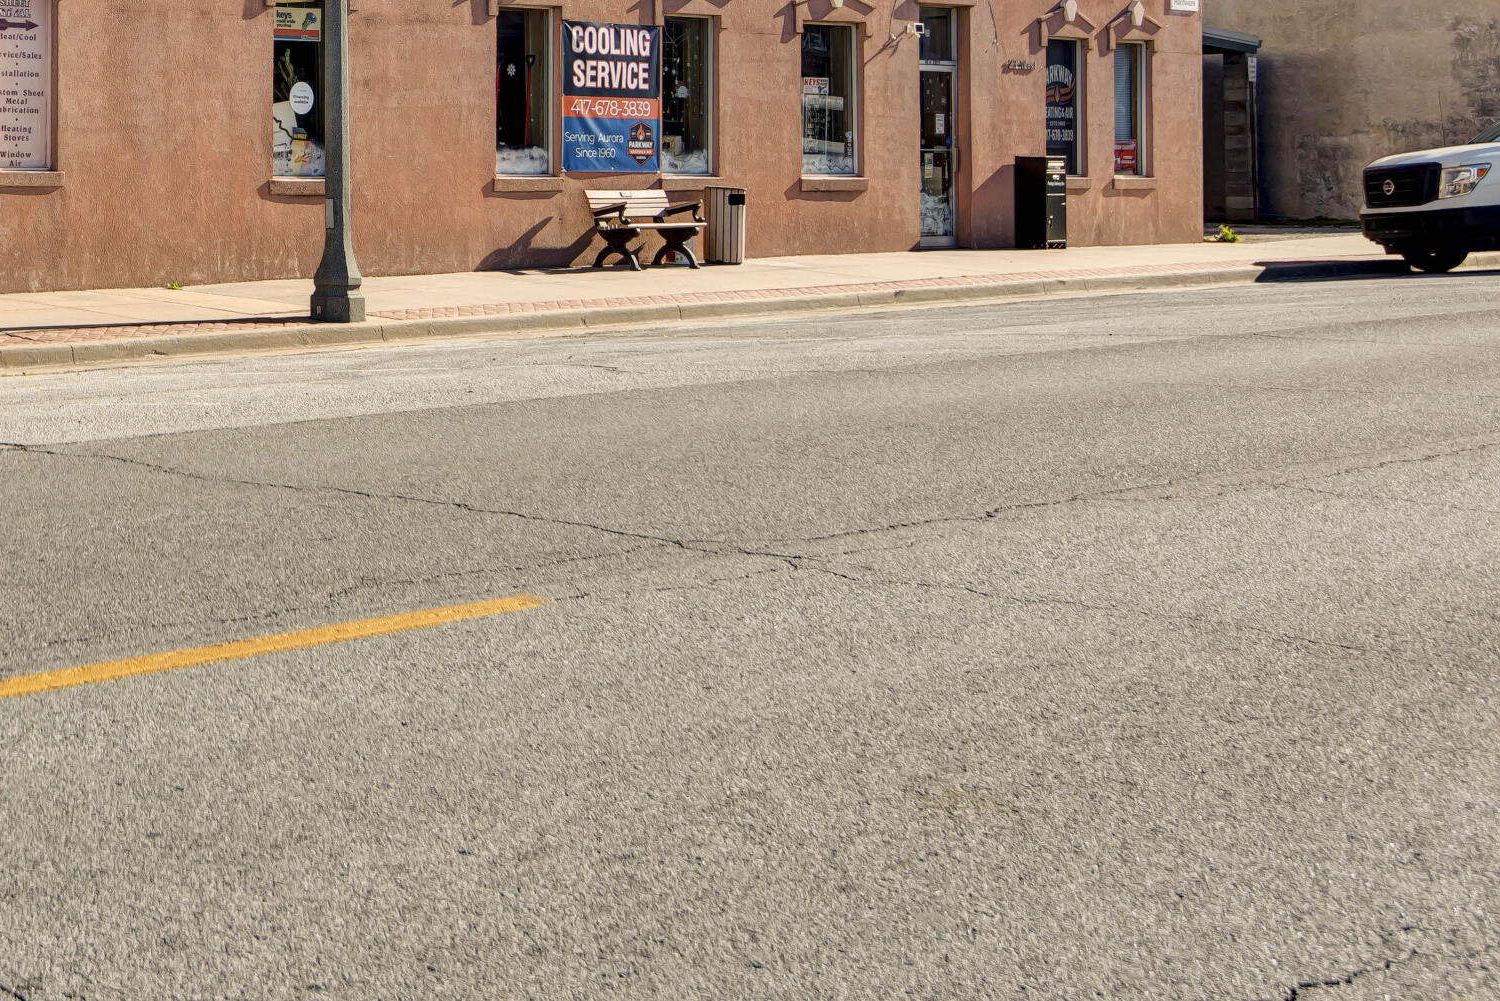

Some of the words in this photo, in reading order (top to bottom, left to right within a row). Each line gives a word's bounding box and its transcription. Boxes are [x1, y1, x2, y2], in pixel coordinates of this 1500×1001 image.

[276, 10, 292, 20] keys
[571, 25, 651, 57] COOLING
[572, 58, 650, 91] SERVICE
[1046, 64, 1073, 87] ARKWAY
[804, 78, 821, 86] KEYS
[22, 89, 44, 97] Sheet
[570, 98, 651, 117] 417-678-3839
[1, 124, 32, 134] Heating
[564, 131, 595, 145] Serving
[597, 132, 624, 143] Aurora
[628, 140, 654, 149] PARKWAY
[0, 150, 32, 159] Window
[575, 147, 597, 158] Since
[597, 147, 616, 159] 1960
